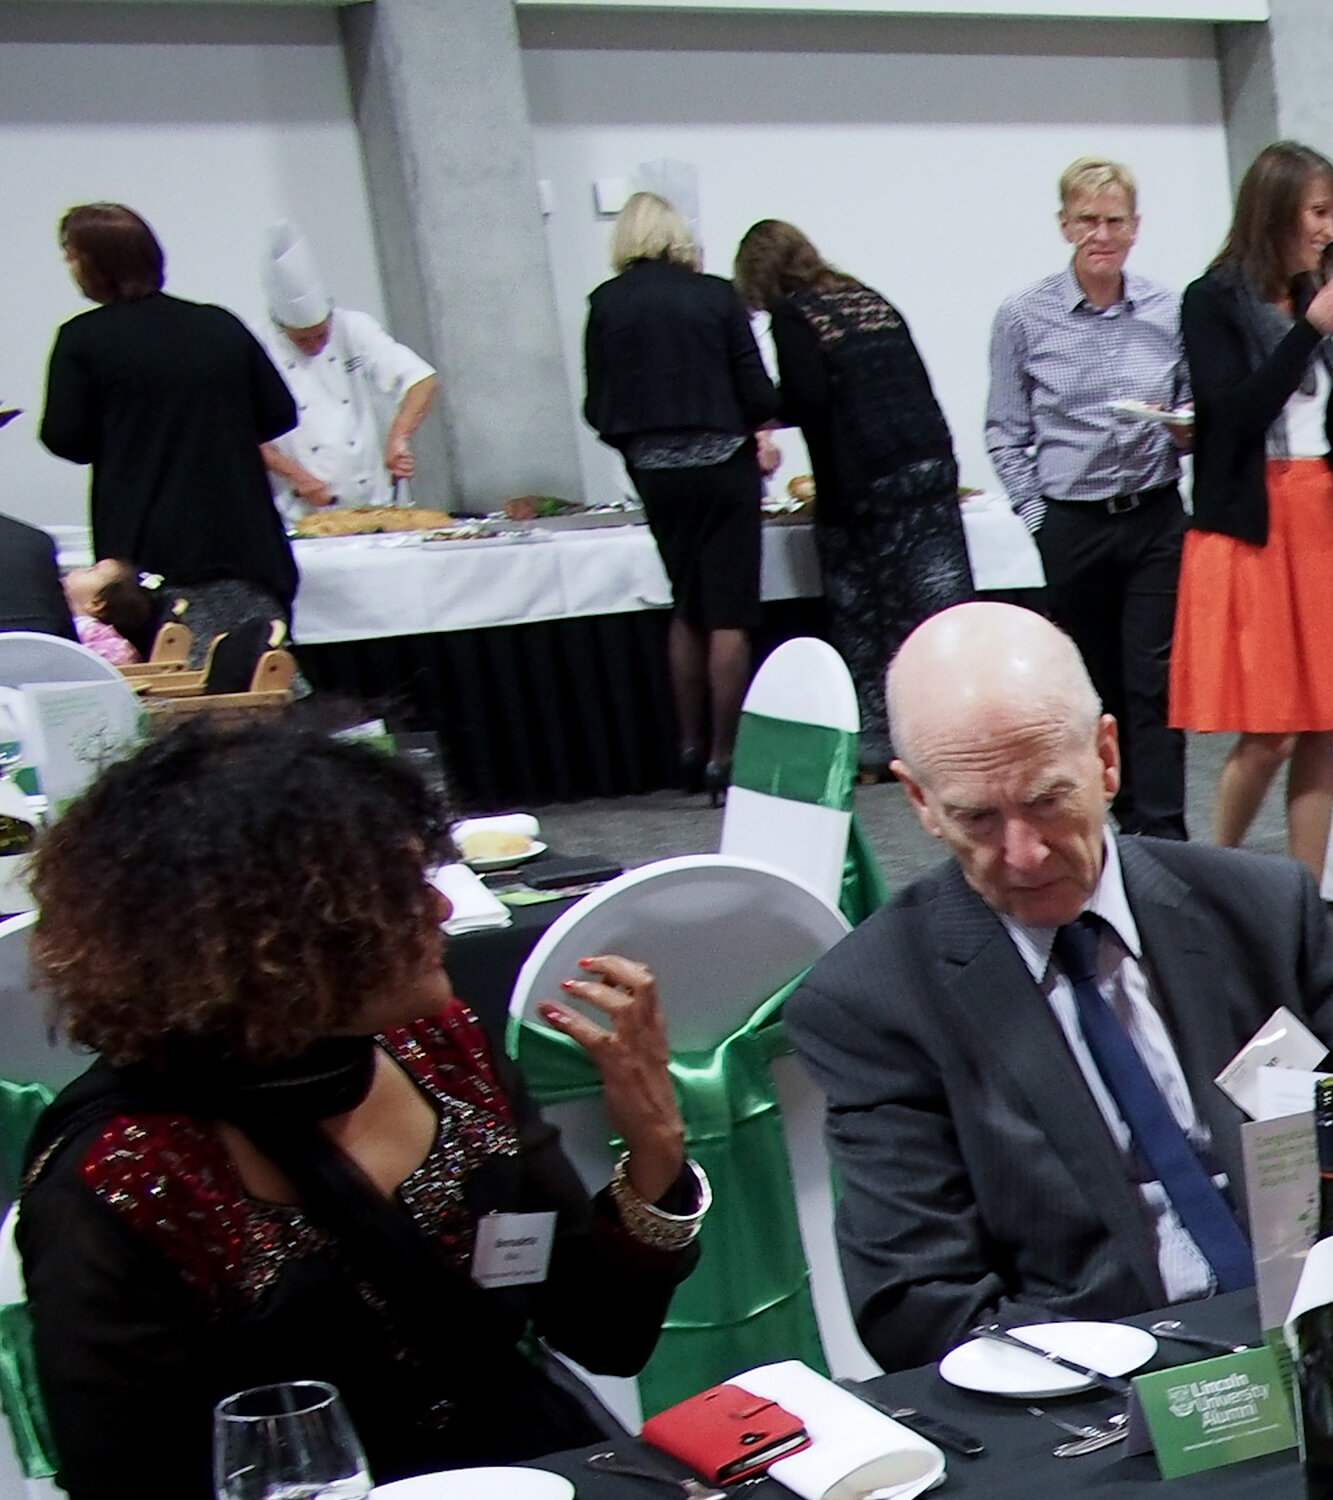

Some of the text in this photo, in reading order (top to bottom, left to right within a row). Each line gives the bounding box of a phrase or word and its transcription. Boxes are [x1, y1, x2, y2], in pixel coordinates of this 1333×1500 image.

[1189, 1373, 1249, 1398] Lincoln
[1197, 1384, 1270, 1412] University
[1202, 1401, 1259, 1428] Alumni
